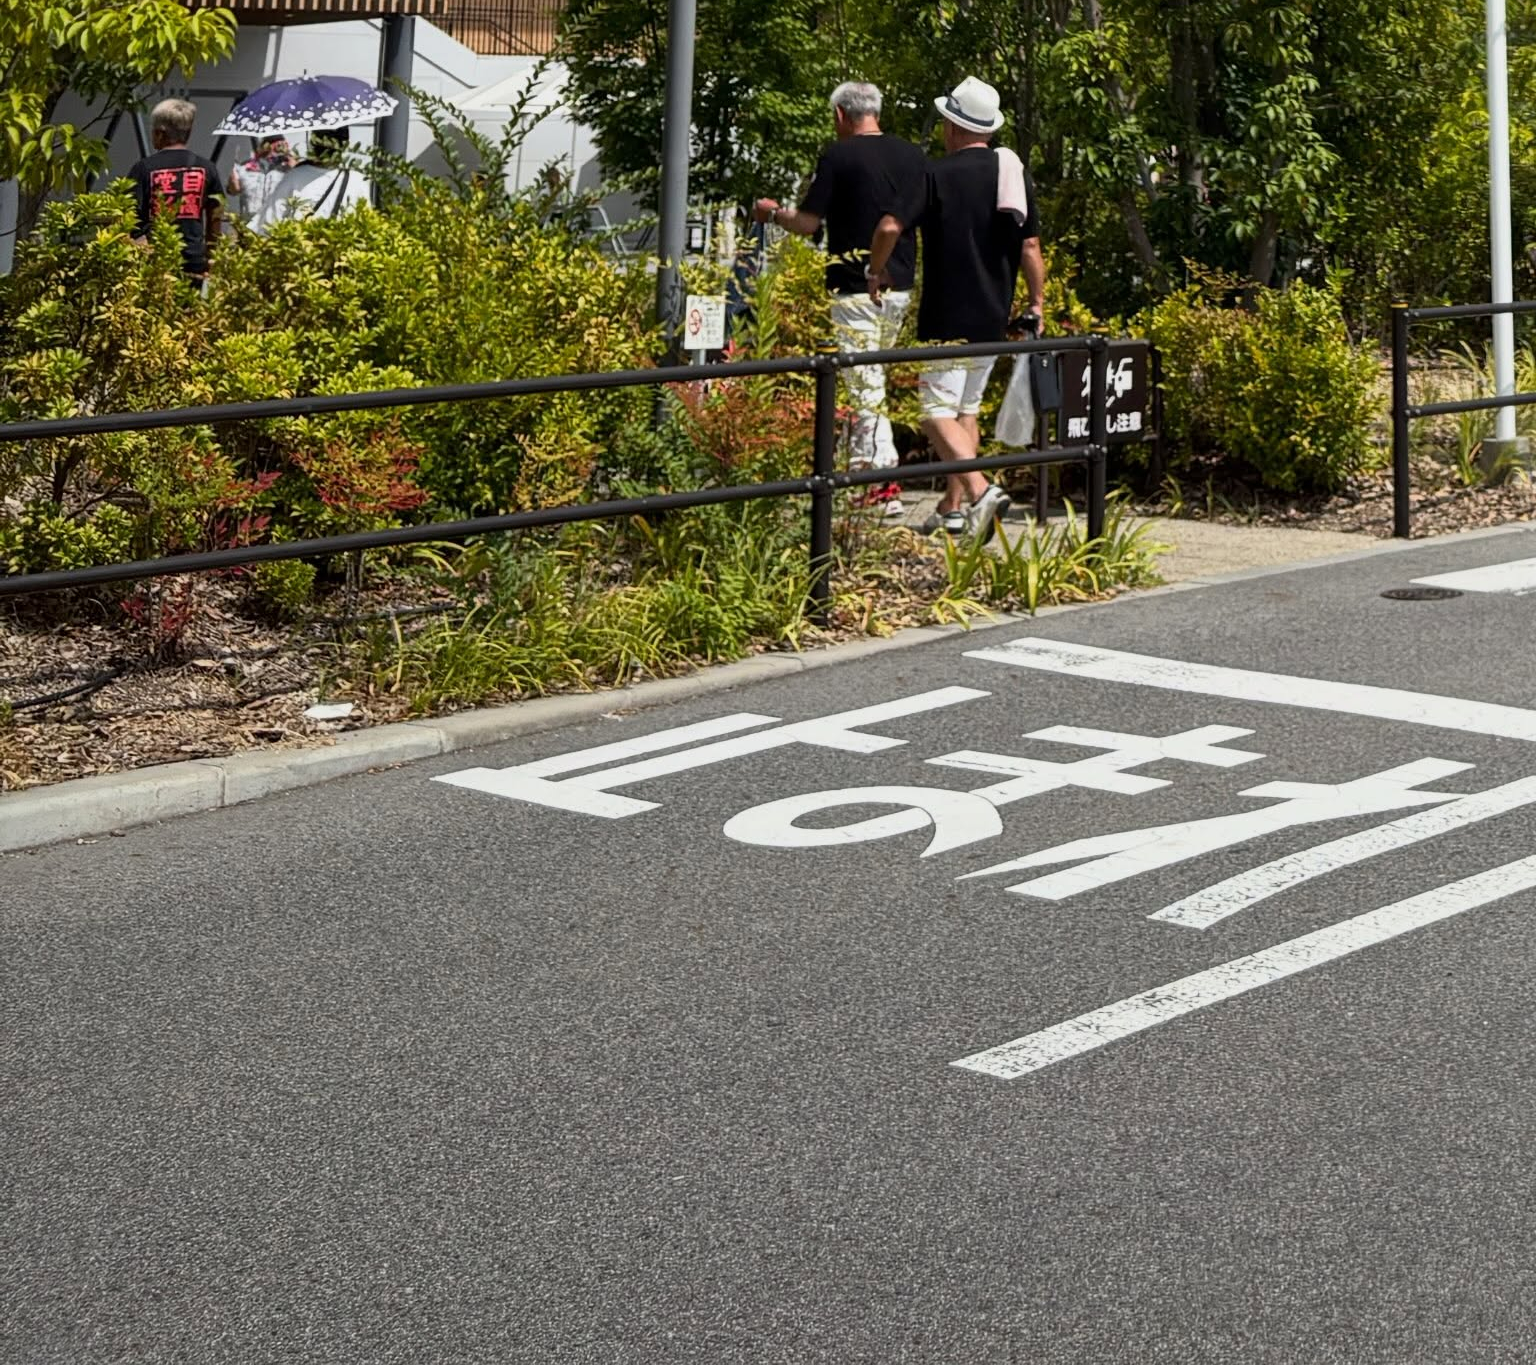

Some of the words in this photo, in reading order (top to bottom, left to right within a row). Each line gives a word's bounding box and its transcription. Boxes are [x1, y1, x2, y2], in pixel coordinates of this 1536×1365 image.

[1067, 411, 1143, 439] 飛びし注意
